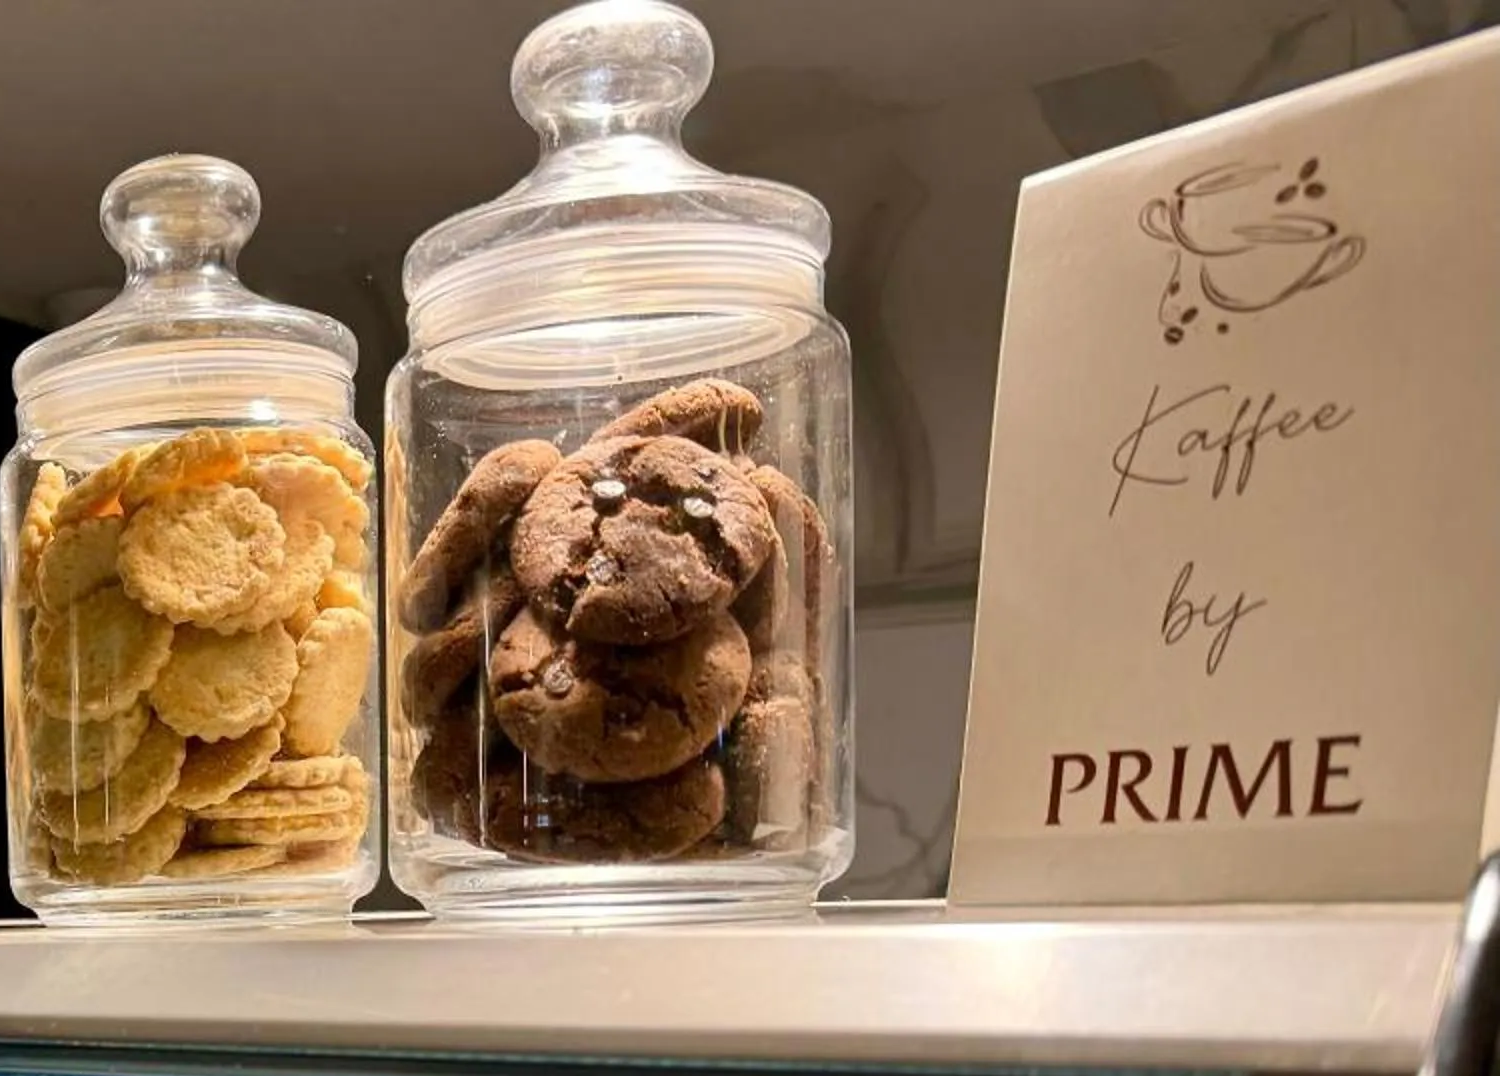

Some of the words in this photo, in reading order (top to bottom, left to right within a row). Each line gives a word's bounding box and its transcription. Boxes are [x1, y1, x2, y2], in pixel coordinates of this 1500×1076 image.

[1109, 384, 1355, 518] Kaffee
[1161, 561, 1267, 676] by
[1045, 733, 1364, 826] PRIME
